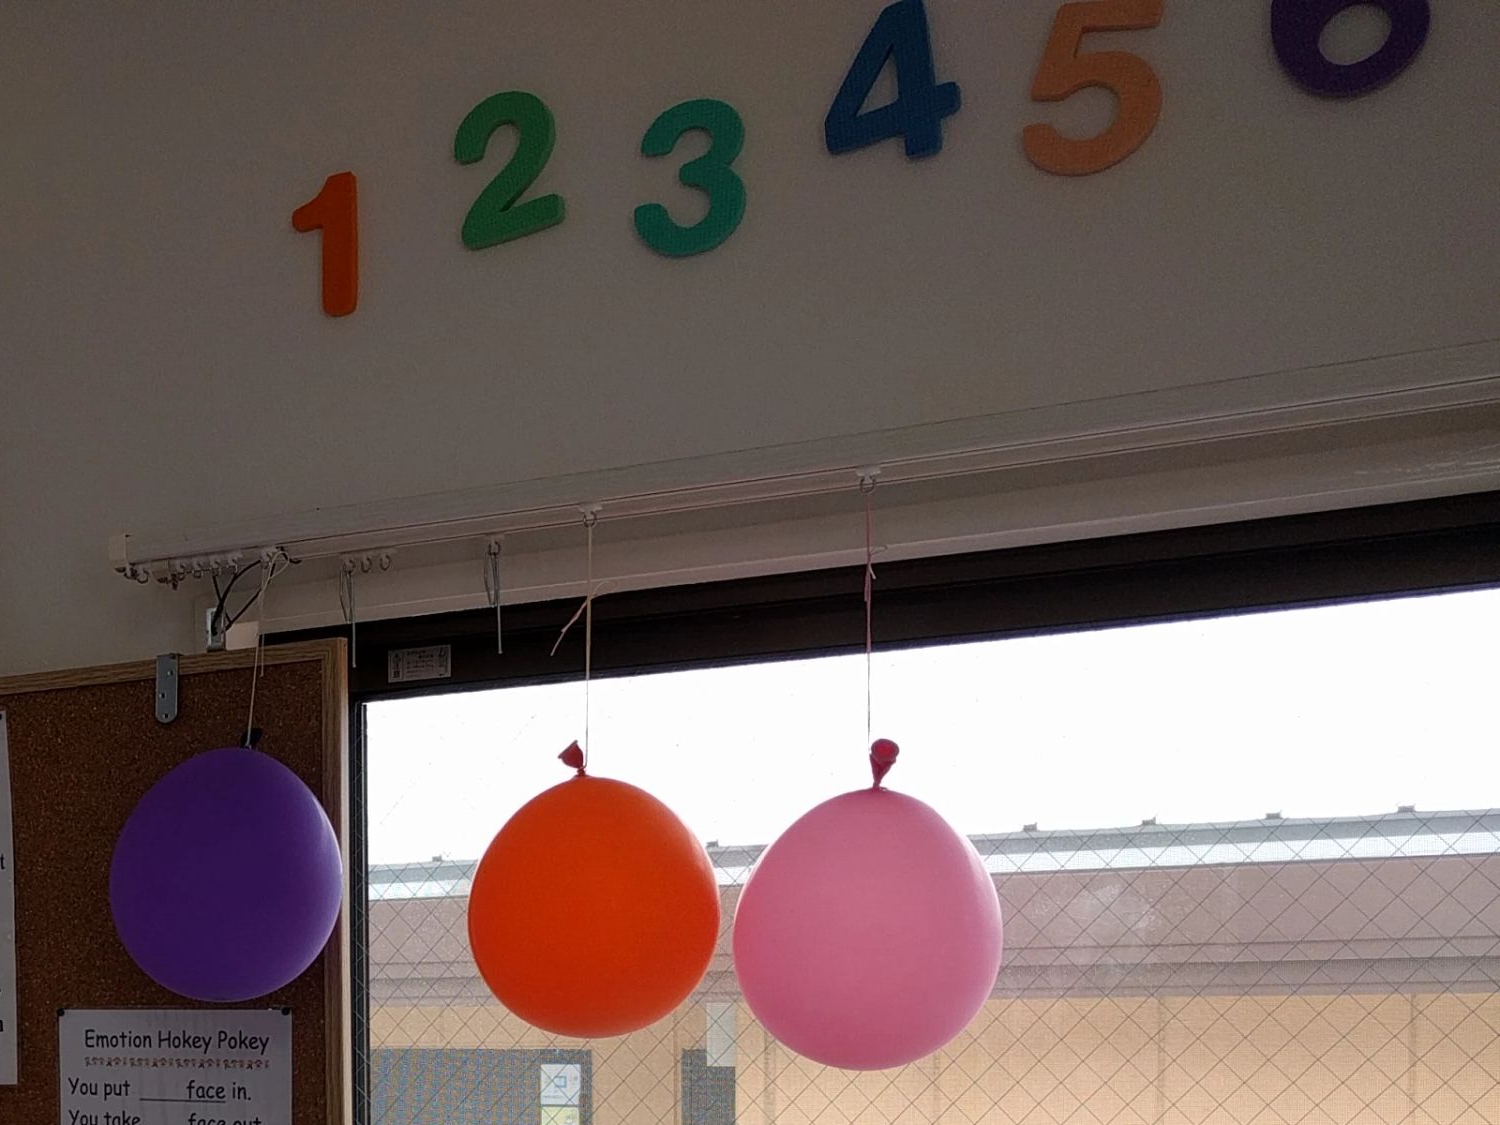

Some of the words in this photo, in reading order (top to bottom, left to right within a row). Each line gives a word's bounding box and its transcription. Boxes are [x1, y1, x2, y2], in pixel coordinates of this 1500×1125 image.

[292, 172, 357, 317] 1
[455, 91, 565, 250] 2
[634, 98, 746, 257] 3
[825, 0, 961, 160] 4
[1022, 0, 1163, 177] 5
[85, 1029, 152, 1048] Emotion
[158, 1030, 212, 1054] Hokey
[218, 1030, 269, 1055] Pokey
[68, 1078, 98, 1095] You
[104, 1080, 130, 1101] put
[187, 1080, 226, 1099] face
[232, 1082, 251, 1100] in.
